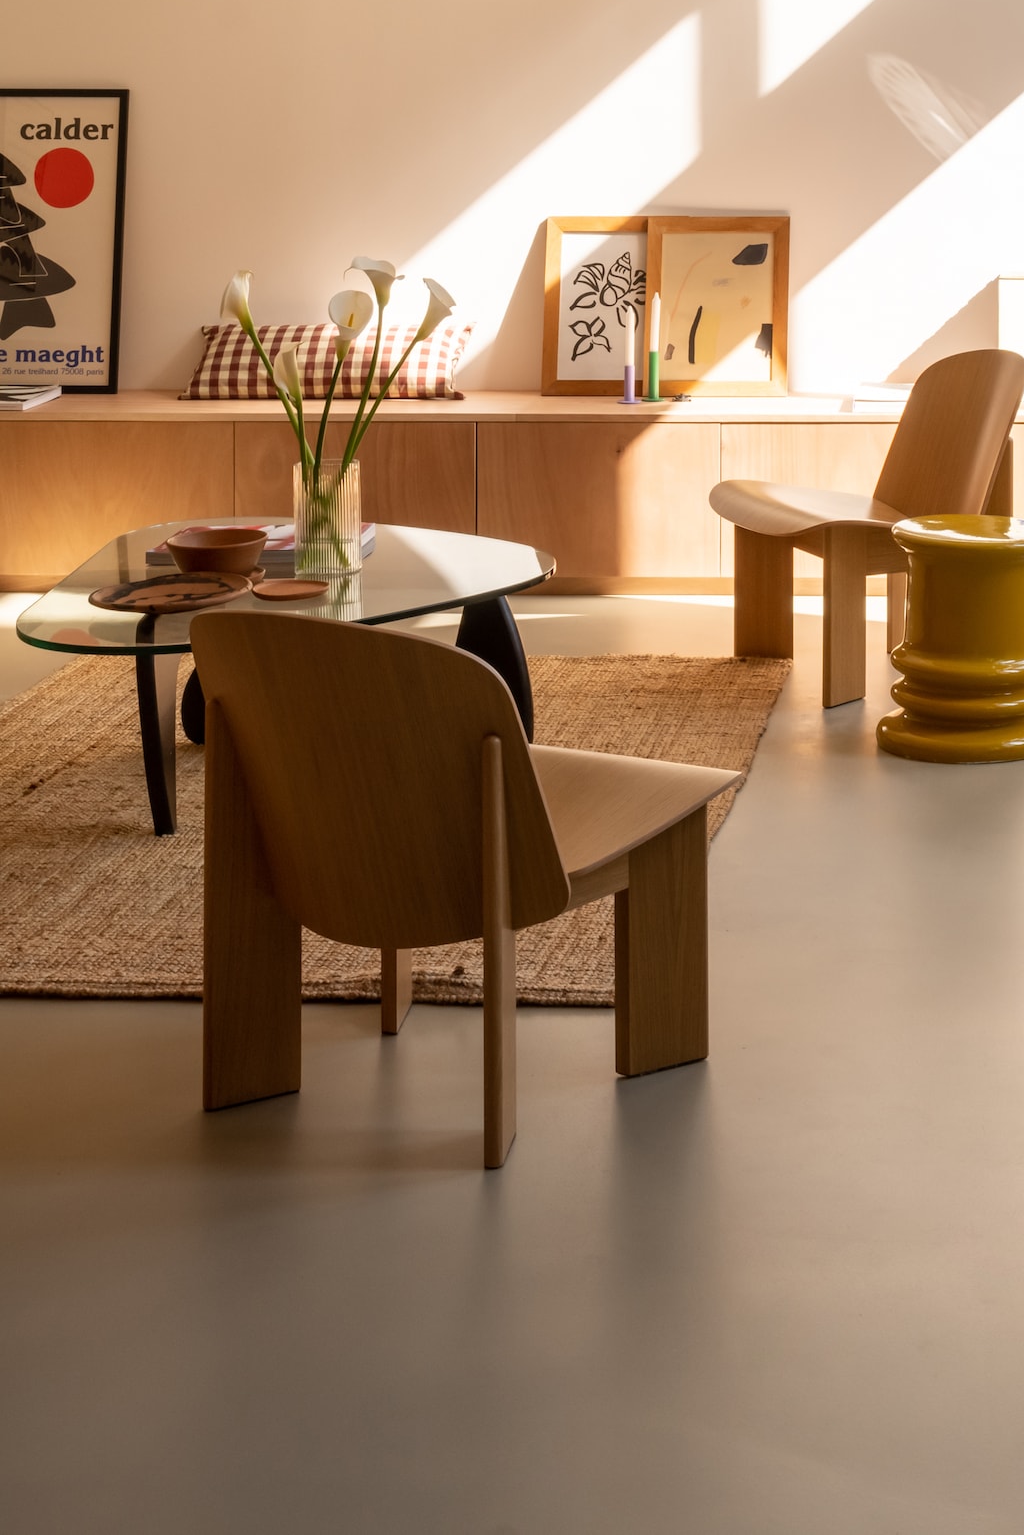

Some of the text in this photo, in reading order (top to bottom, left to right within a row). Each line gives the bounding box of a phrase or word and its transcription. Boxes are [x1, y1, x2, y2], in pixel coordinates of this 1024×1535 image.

[20, 117, 114, 140] calder
[15, 344, 104, 368] maeght
[2, 367, 12, 375] 26
[61, 367, 84, 375] 75008
[86, 368, 104, 377] paris
